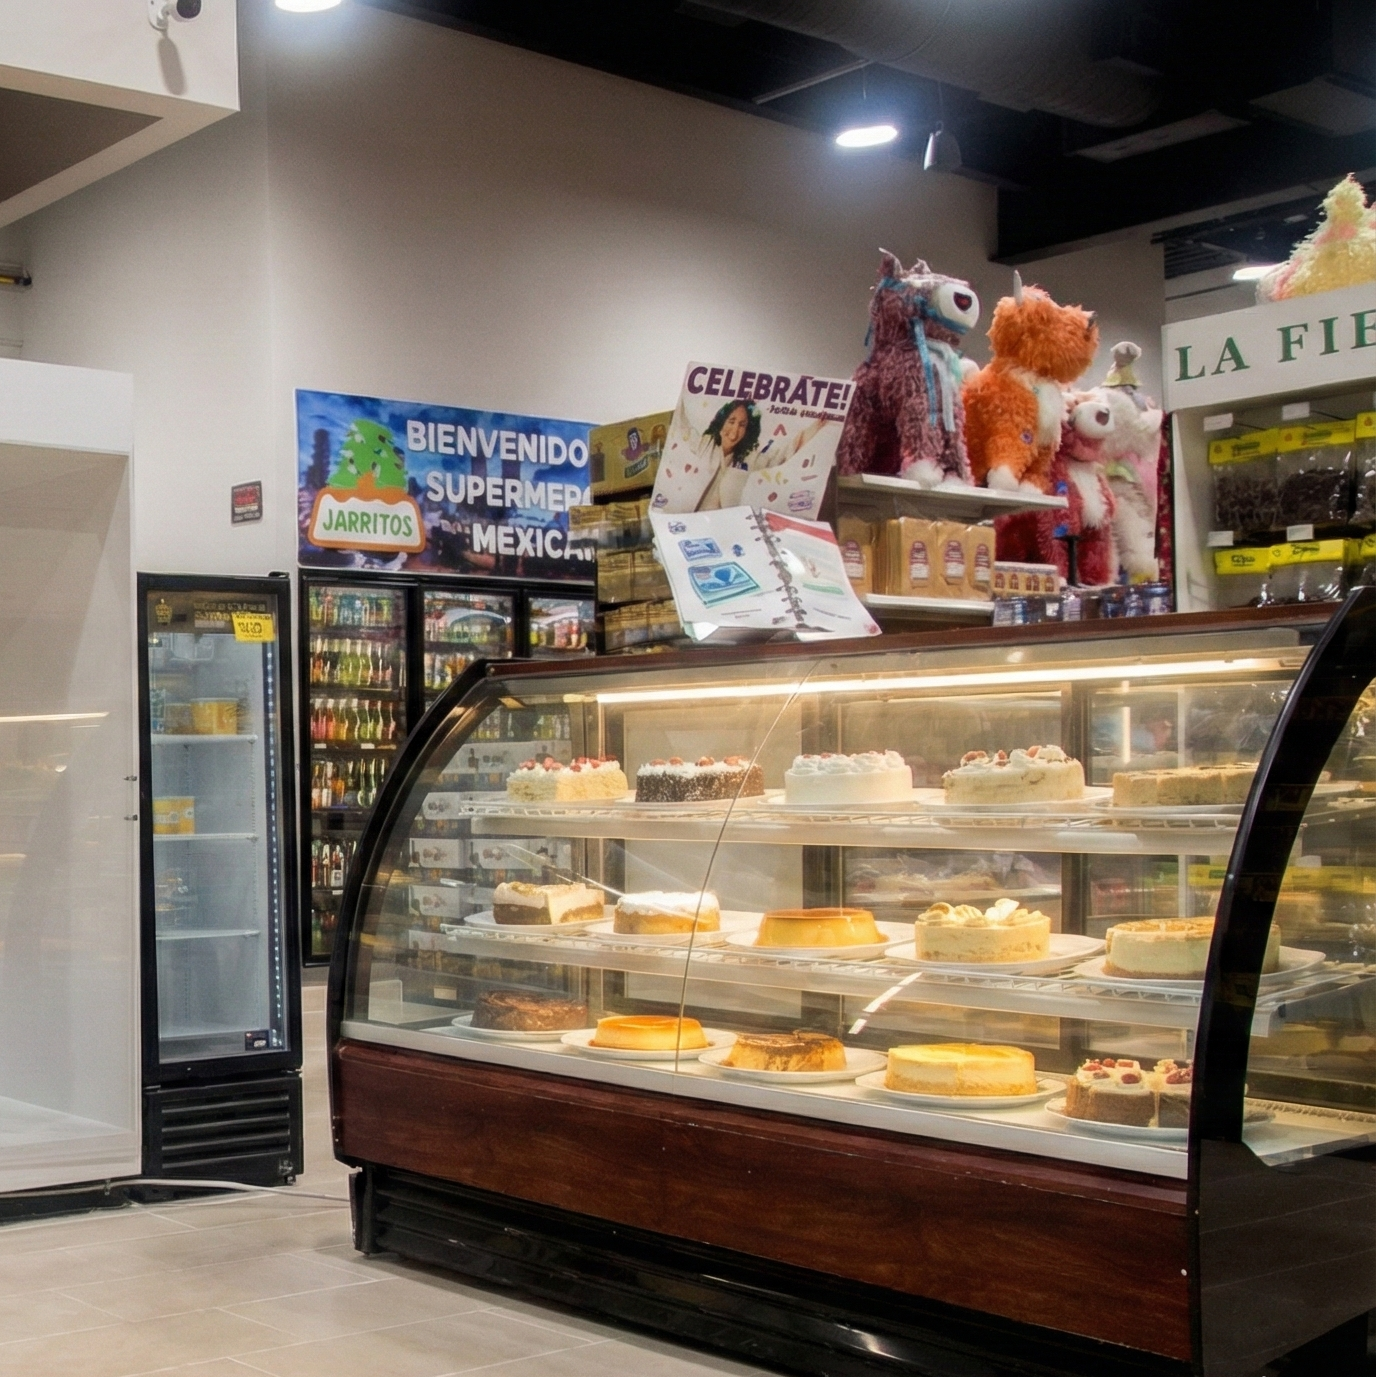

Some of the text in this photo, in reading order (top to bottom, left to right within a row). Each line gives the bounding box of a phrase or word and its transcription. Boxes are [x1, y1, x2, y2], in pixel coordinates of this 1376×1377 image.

[1175, 336, 1251, 382] LA
[687, 366, 852, 411] CELEBRATE!
[406, 419, 589, 468] BIENVENIDO
[322, 508, 413, 538] JARRITOS
[472, 522, 595, 561] MEXICA
